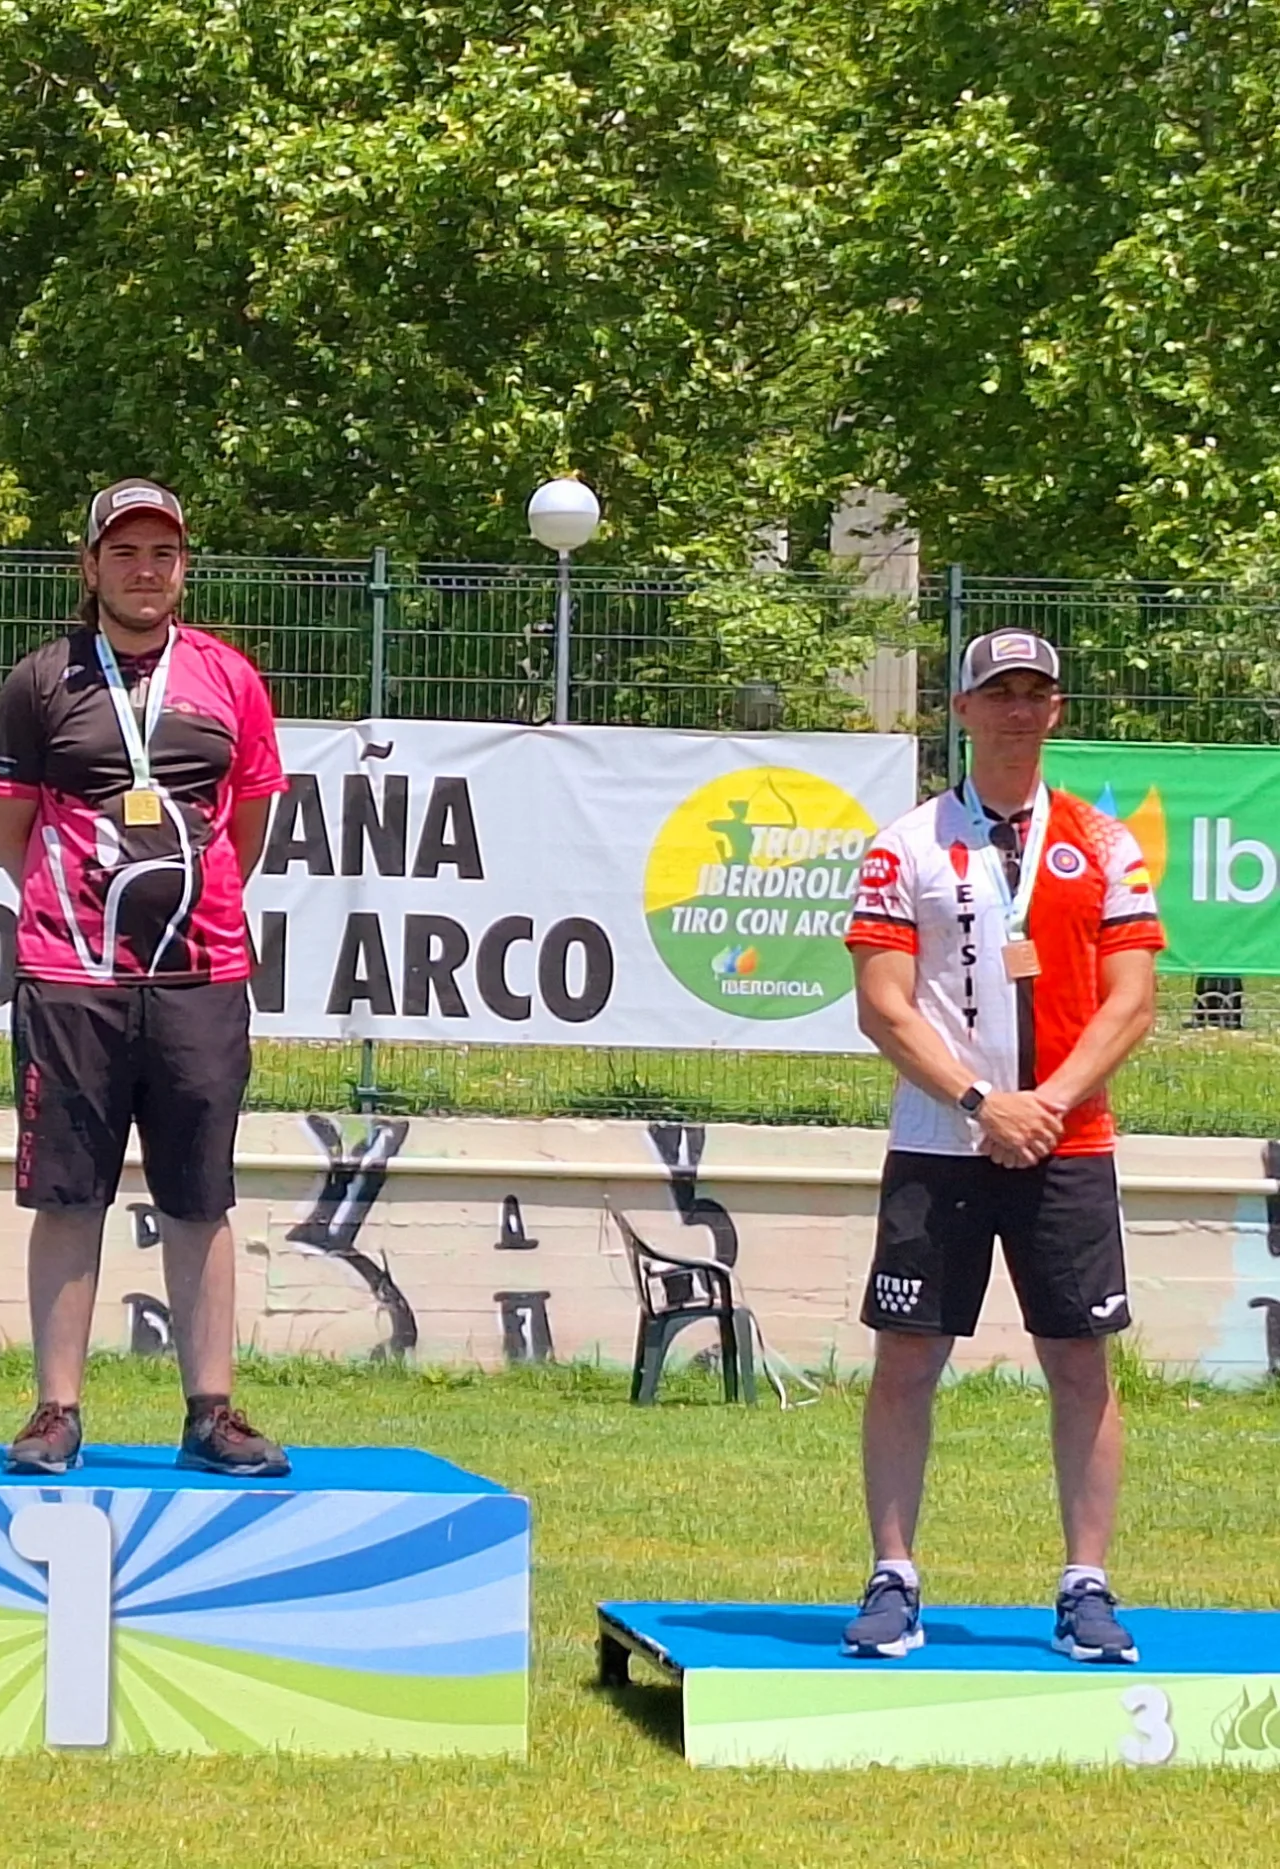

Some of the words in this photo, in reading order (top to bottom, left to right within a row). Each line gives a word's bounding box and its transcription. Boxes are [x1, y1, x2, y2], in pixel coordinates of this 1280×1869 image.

[260, 741, 484, 880] AÑA
[749, 826, 866, 861] TROFEO
[697, 863, 861, 900] IBERDROLA
[1192, 817, 1278, 904] Ib
[671, 906, 729, 934] TIRO
[735, 908, 789, 936] CON
[244, 911, 288, 1013] N
[325, 912, 615, 1023] ARCO
[721, 979, 824, 997] IBERDROLA
[9, 1502, 111, 1746] 1
[1121, 1684, 1177, 1765] 3
